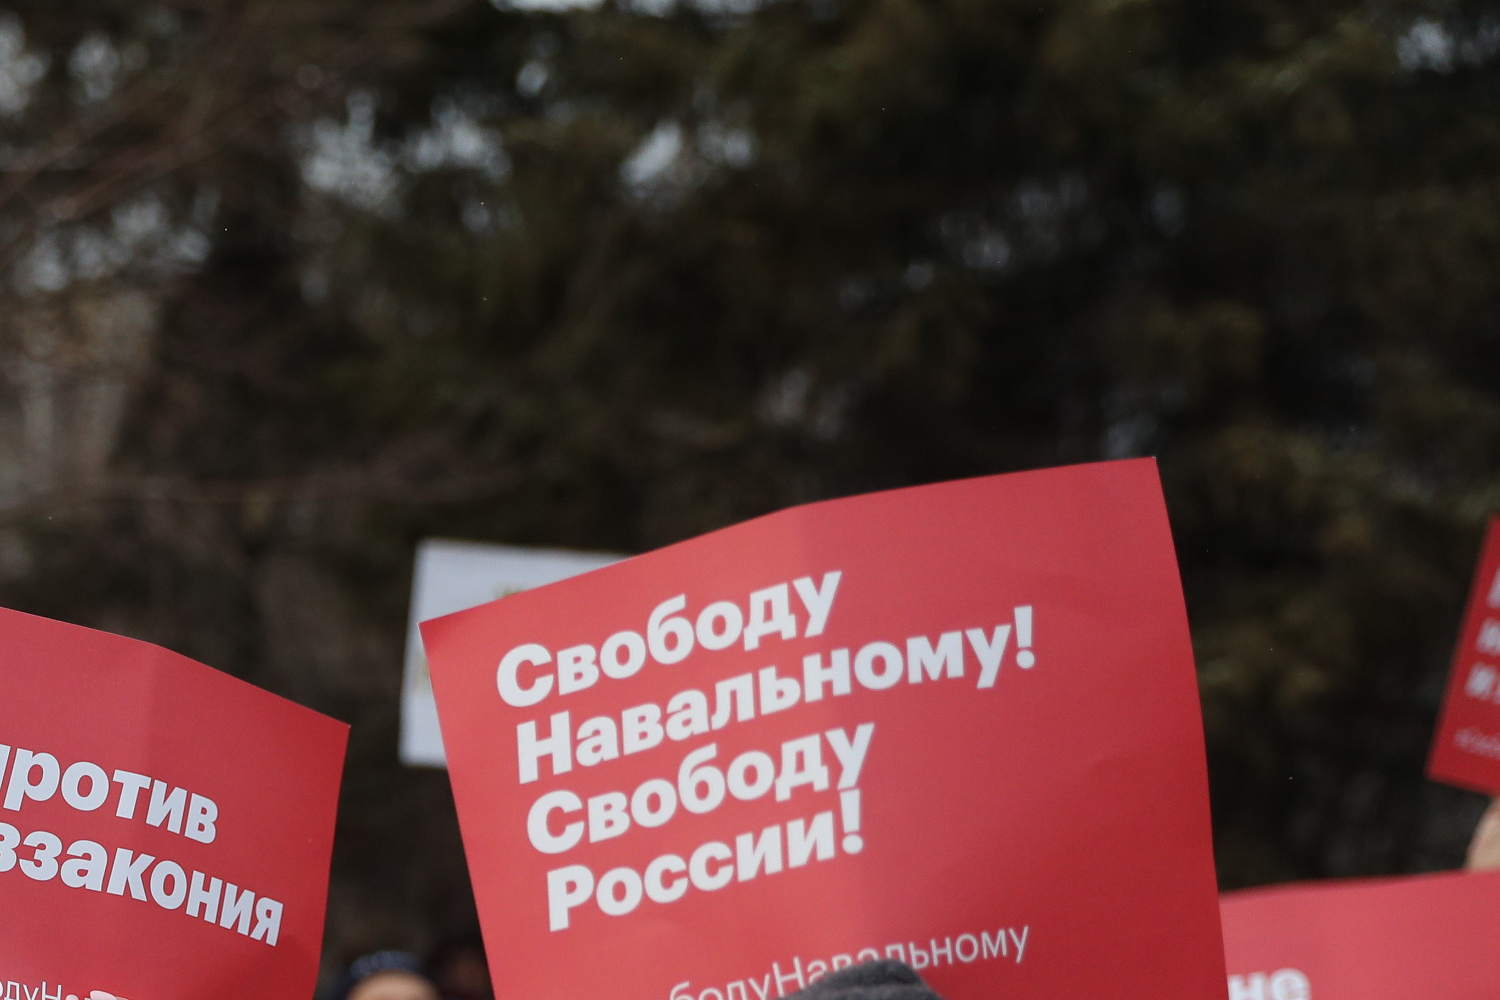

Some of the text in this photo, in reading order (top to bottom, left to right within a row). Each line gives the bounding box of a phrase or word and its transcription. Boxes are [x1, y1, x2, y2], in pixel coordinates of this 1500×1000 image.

[497, 570, 842, 708] Свободу
[516, 605, 1036, 785] Навальному!
[526, 722, 876, 855] Свободу
[546, 788, 865, 932] России!
